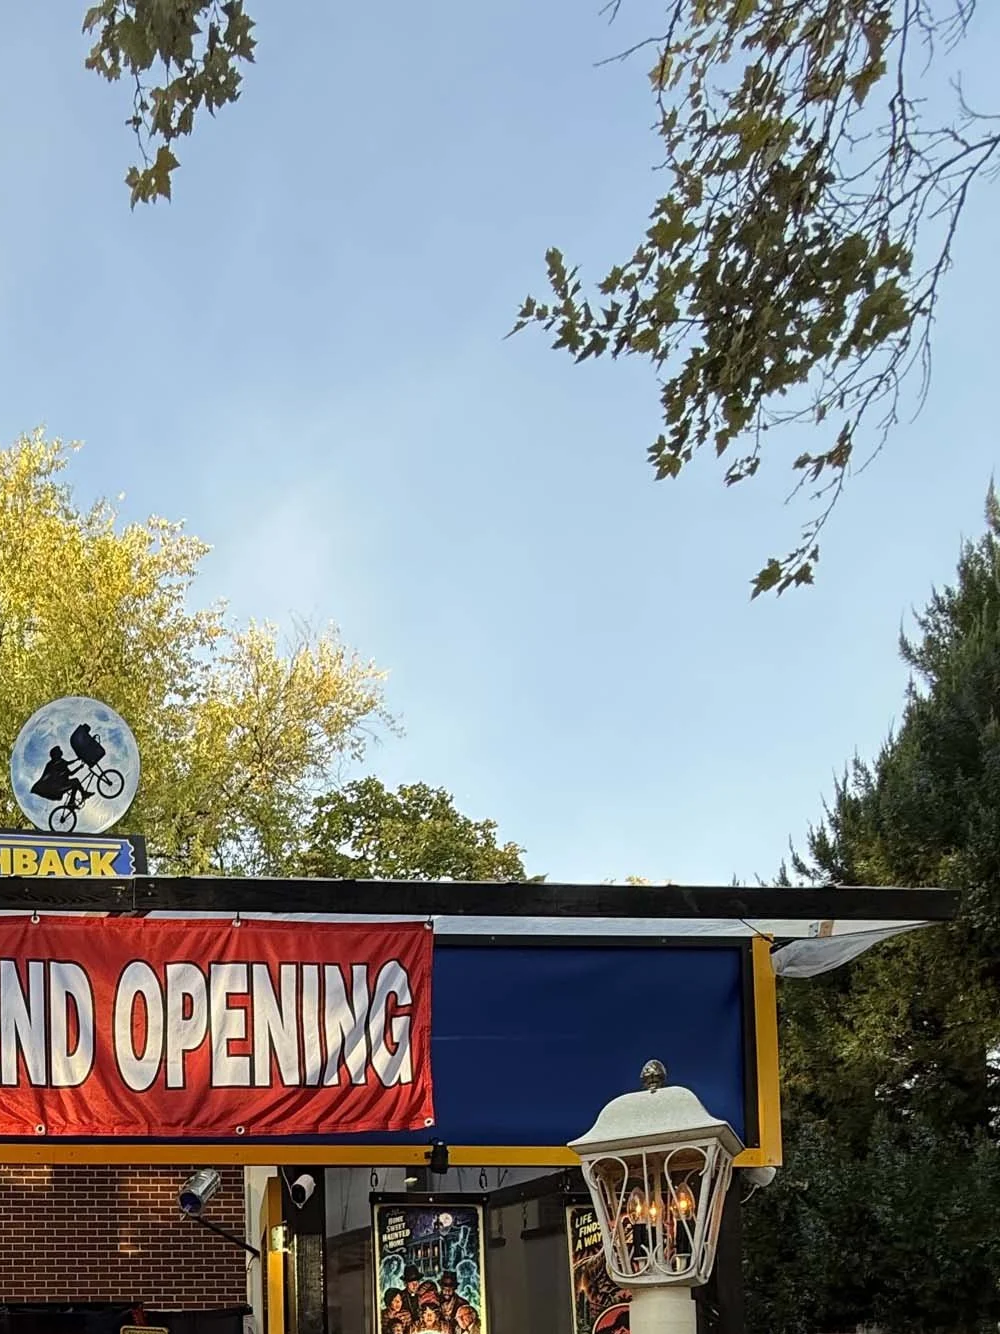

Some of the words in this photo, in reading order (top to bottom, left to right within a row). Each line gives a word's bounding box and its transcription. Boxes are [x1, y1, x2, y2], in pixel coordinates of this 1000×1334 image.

[113, 958, 413, 1092] OPENING
[386, 1222, 406, 1233] SWEET
[575, 1212, 593, 1229] LIFE
[382, 1228, 411, 1242] HAUNTED
[575, 1239, 583, 1252] A
[584, 1231, 603, 1248] WAY
